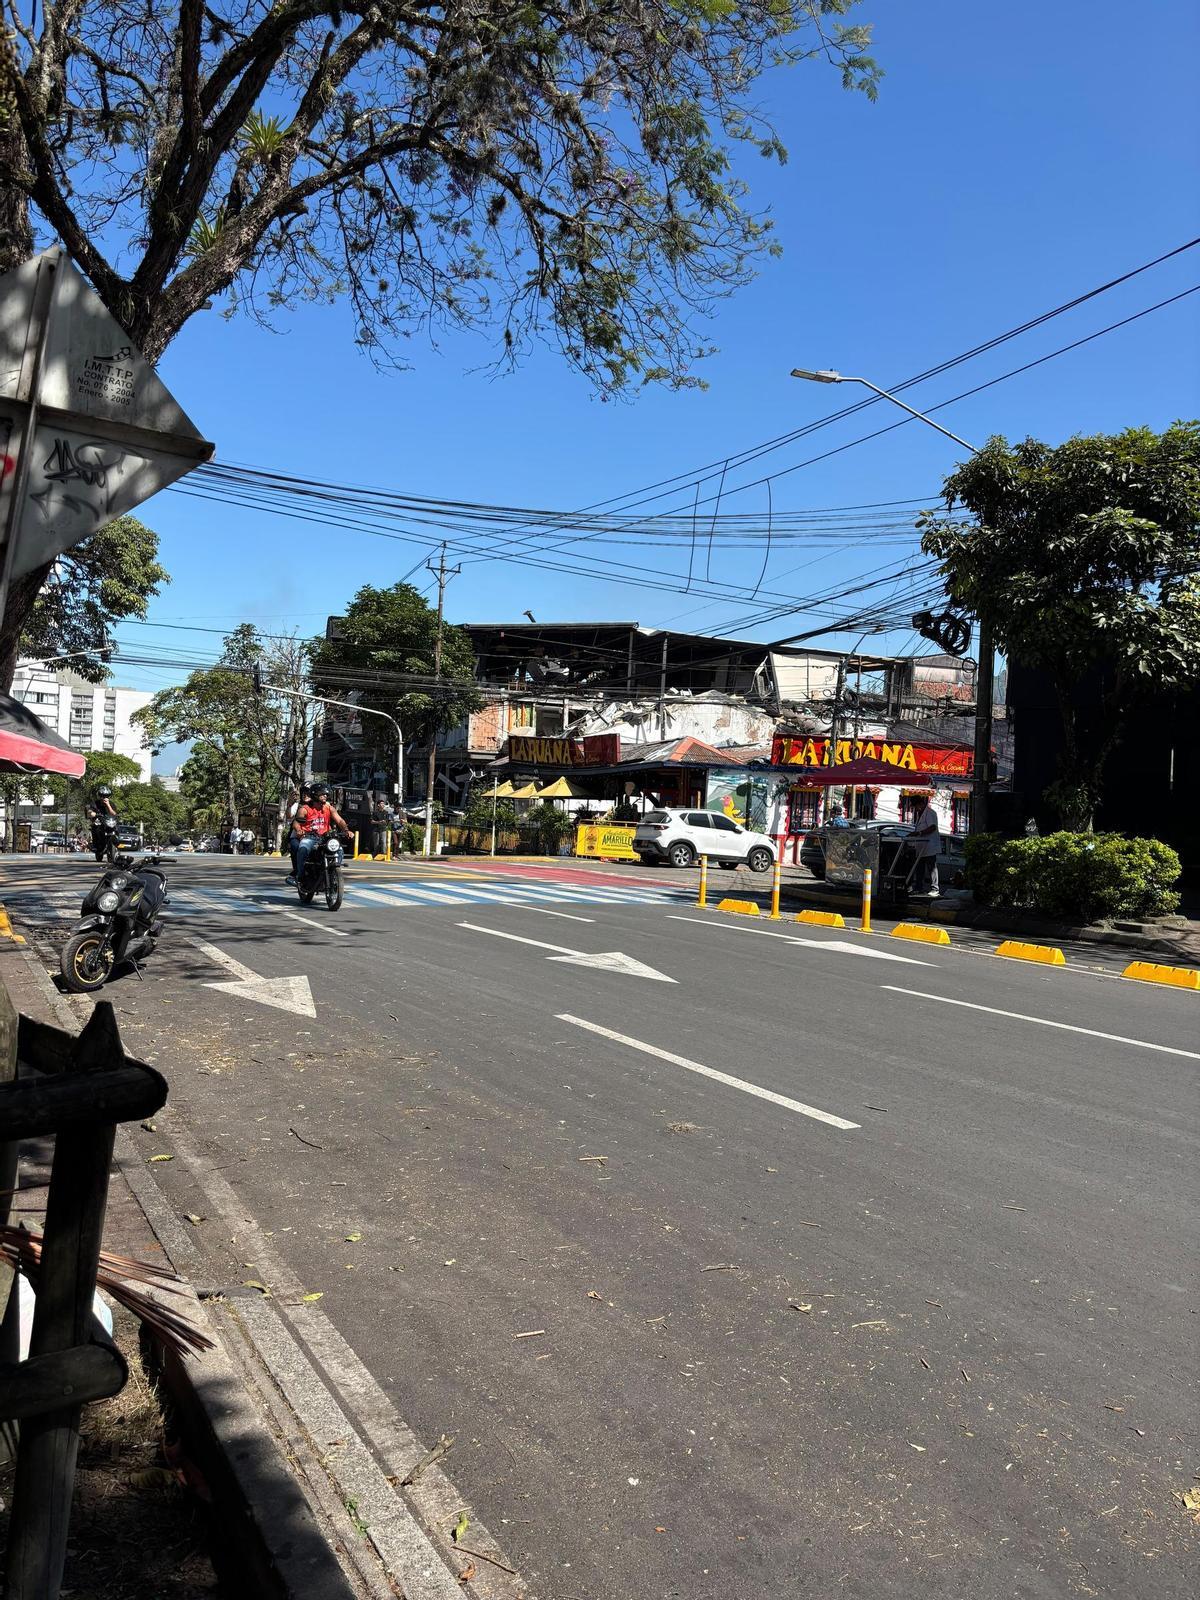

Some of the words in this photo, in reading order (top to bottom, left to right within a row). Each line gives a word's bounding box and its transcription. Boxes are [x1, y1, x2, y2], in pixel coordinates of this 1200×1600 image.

[84, 371, 133, 389] CONTRATO
[78, 386, 104, 398] Enero
[111, 395, 130, 405] 2005
[93, 381, 109, 391] 076
[116, 387, 135, 398] 2004
[782, 738, 819, 766] LA
[823, 739, 918, 770] RUANA
[602, 834, 634, 847] AMARILLO
